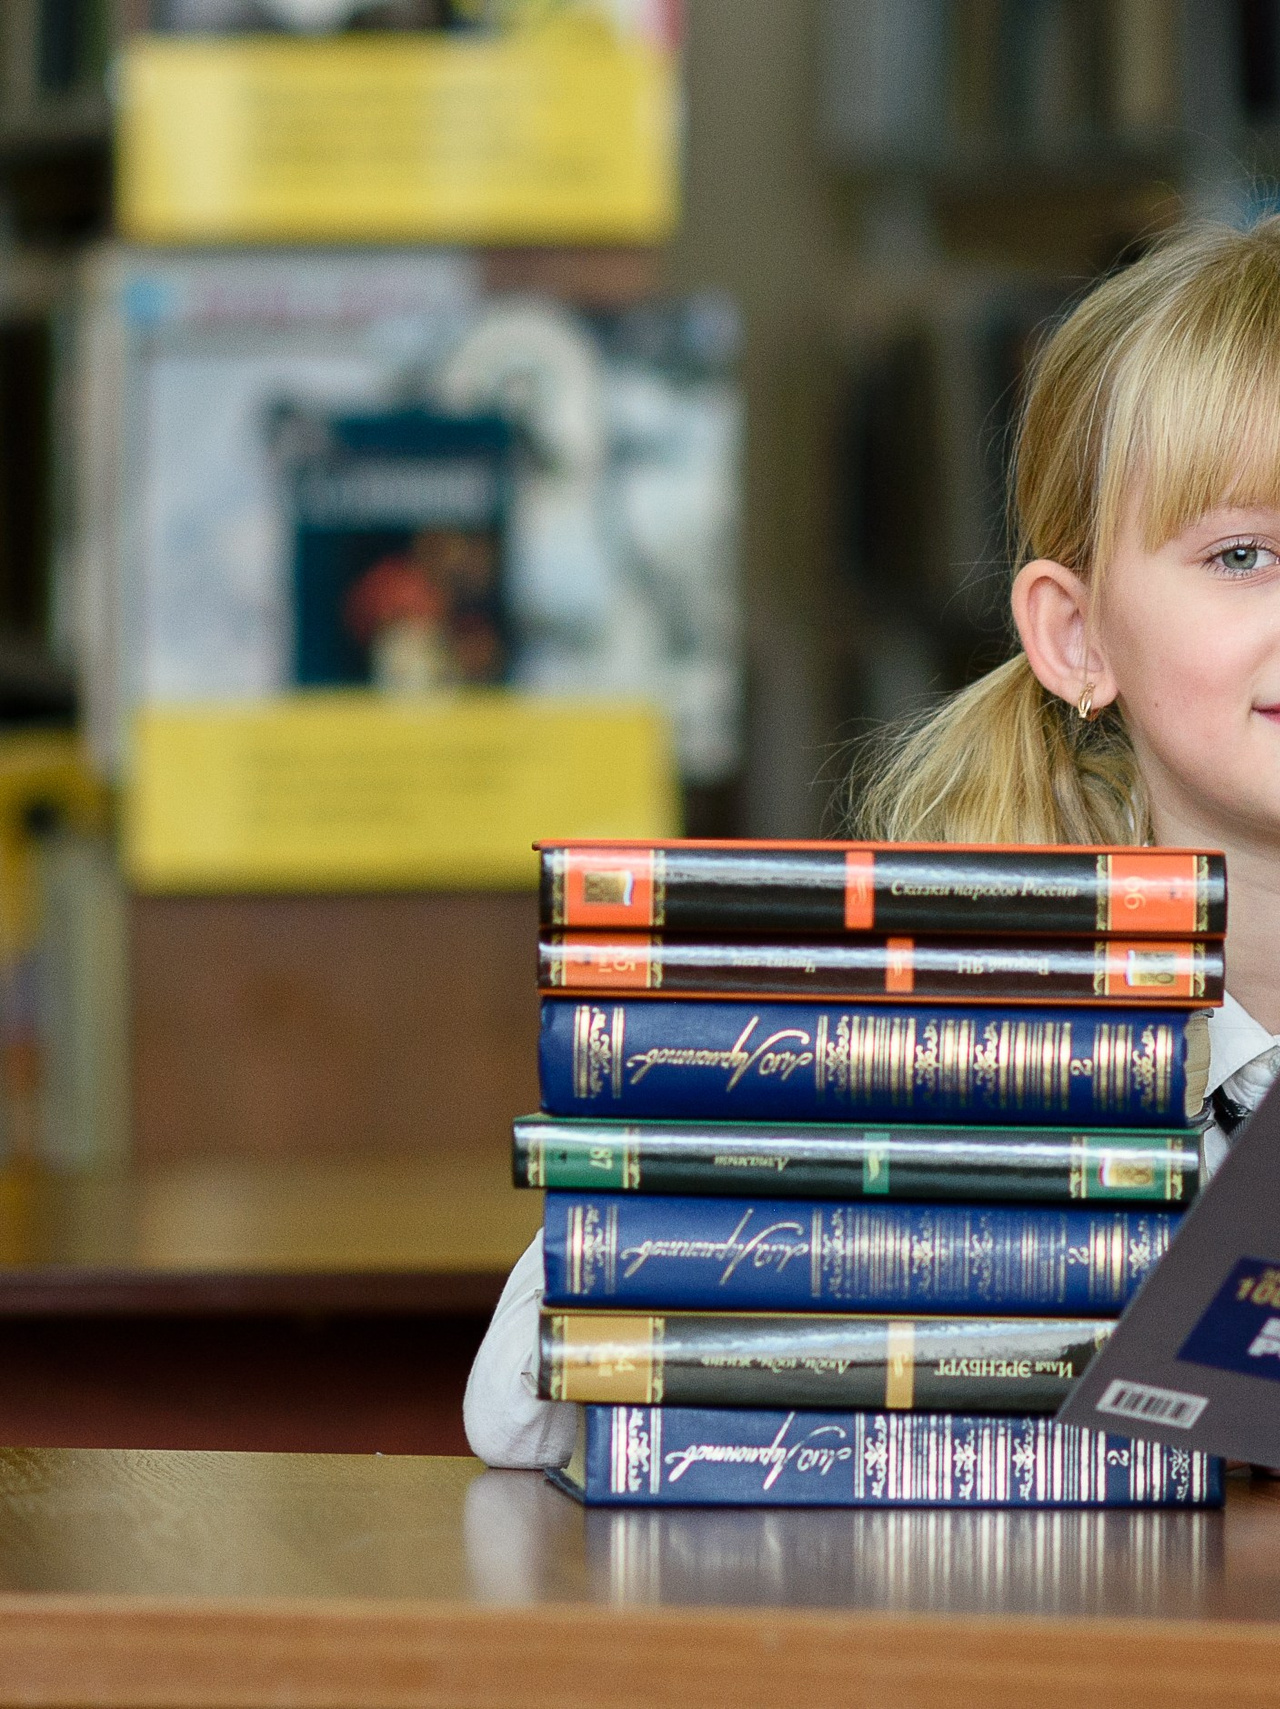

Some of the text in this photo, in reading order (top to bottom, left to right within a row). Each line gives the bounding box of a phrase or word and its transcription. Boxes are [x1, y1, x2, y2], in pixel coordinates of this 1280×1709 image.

[891, 876, 1078, 900] Сказки народов России
[590, 1147, 613, 1170] 87
[934, 1359, 1073, 1379] Илья ЭРЕНБУРГ
